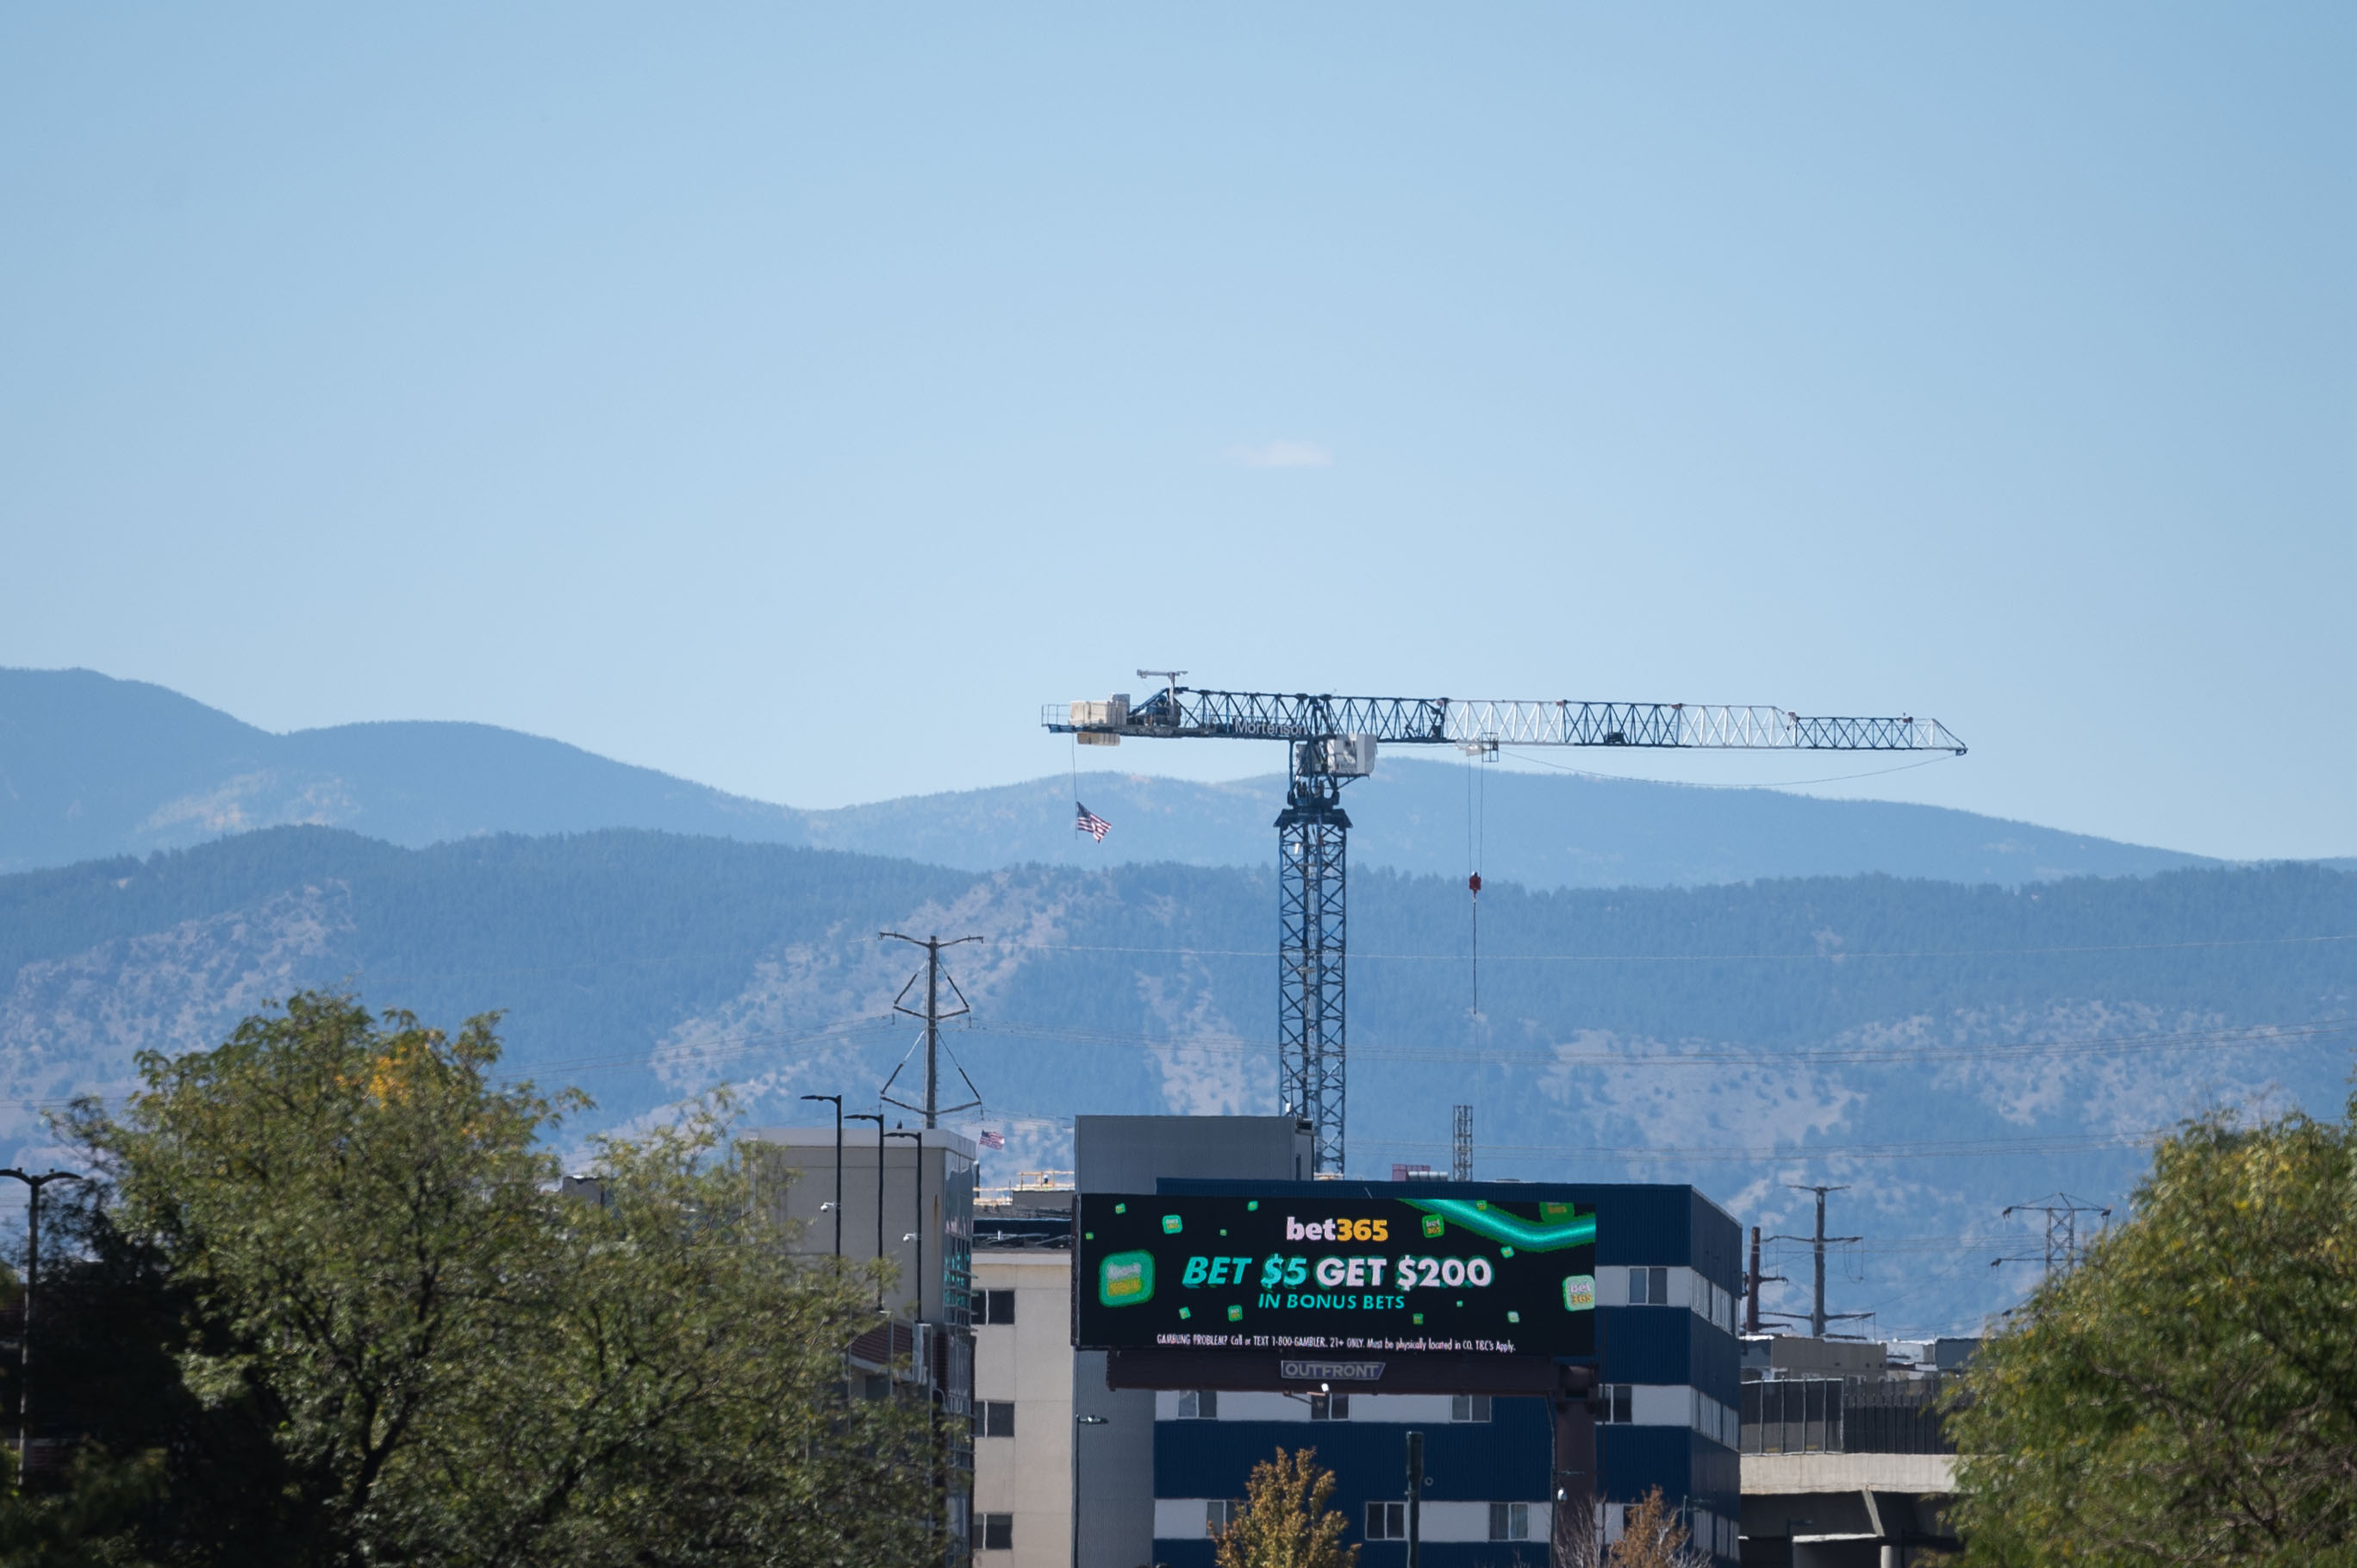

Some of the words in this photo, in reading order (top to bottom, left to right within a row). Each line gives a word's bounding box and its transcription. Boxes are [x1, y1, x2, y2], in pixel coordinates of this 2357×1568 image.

[1235, 720, 1306, 735] Mortenson
[1286, 1216, 1388, 1241] bet365
[1182, 1256, 1252, 1286] BET
[1261, 1254, 1307, 1289] $5
[1316, 1257, 1387, 1287] GET
[1397, 1254, 1492, 1291] $200
[1258, 1293, 1281, 1309] IN
[1287, 1294, 1356, 1310] BONUS
[1362, 1295, 1405, 1310] BETS
[1157, 1334, 1191, 1345] GAMBLING
[1193, 1335, 1228, 1346] PROBLEM?
[1231, 1334, 1243, 1346] Call
[1253, 1335, 1269, 1347] TEXT
[1330, 1337, 1344, 1348] 21+
[1367, 1338, 1382, 1349] Must
[1384, 1337, 1394, 1349] be
[1395, 1337, 1426, 1352] physically
[1428, 1337, 1452, 1351] located
[1455, 1340, 1462, 1350] in
[1495, 1339, 1516, 1353] Apply.
[1285, 1364, 1380, 1378] OUTFRONT
